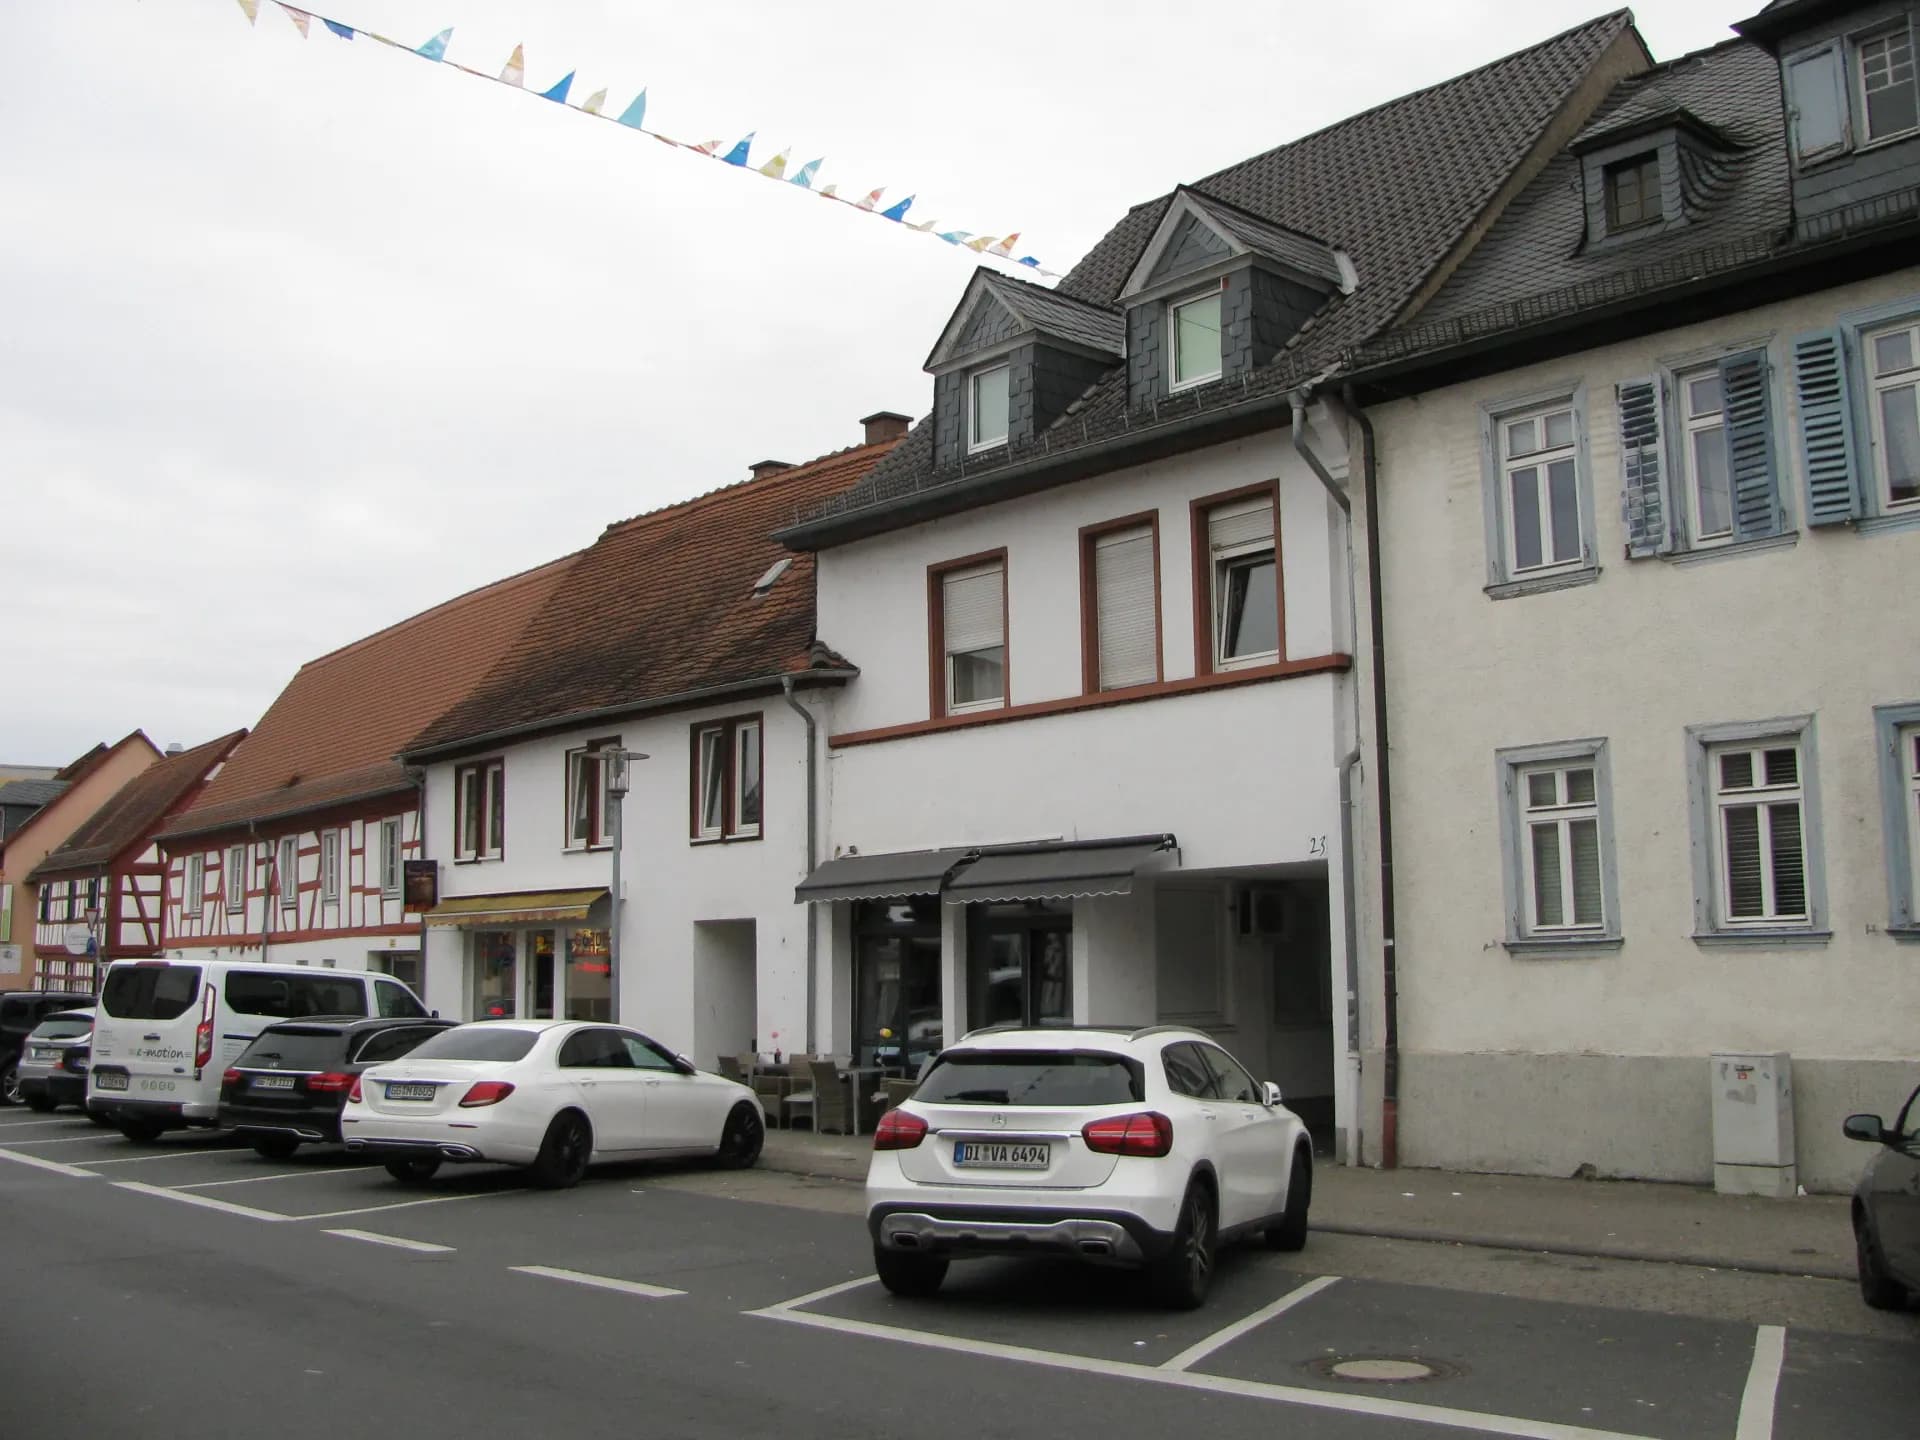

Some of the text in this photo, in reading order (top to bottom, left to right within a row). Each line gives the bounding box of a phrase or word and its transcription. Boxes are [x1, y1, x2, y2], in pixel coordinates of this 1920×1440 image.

[1309, 835, 1326, 857] 23
[964, 1145, 1045, 1163] DI VA 6494
